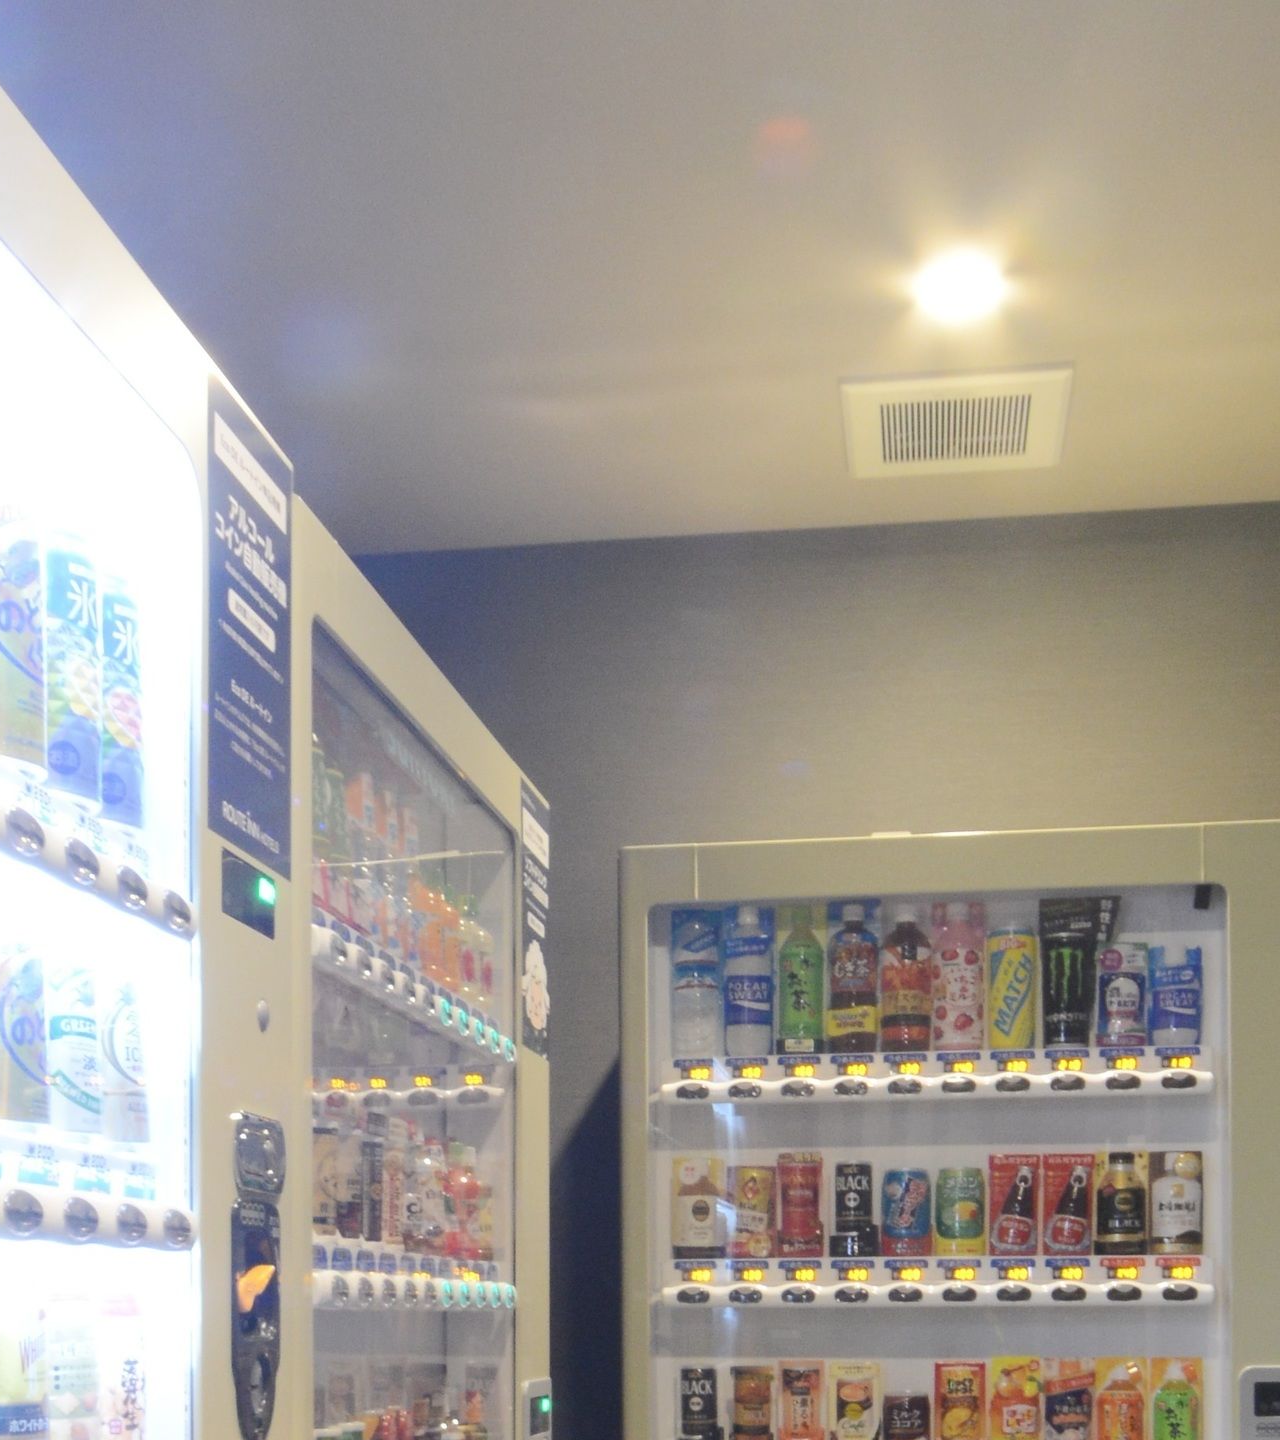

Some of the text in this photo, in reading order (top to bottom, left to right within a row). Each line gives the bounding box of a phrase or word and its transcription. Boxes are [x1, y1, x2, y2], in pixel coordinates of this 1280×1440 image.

[994, 953, 1032, 1036] MATCH
[836, 1176, 869, 1191] BLACK
[681, 1380, 713, 1395] BLACK
